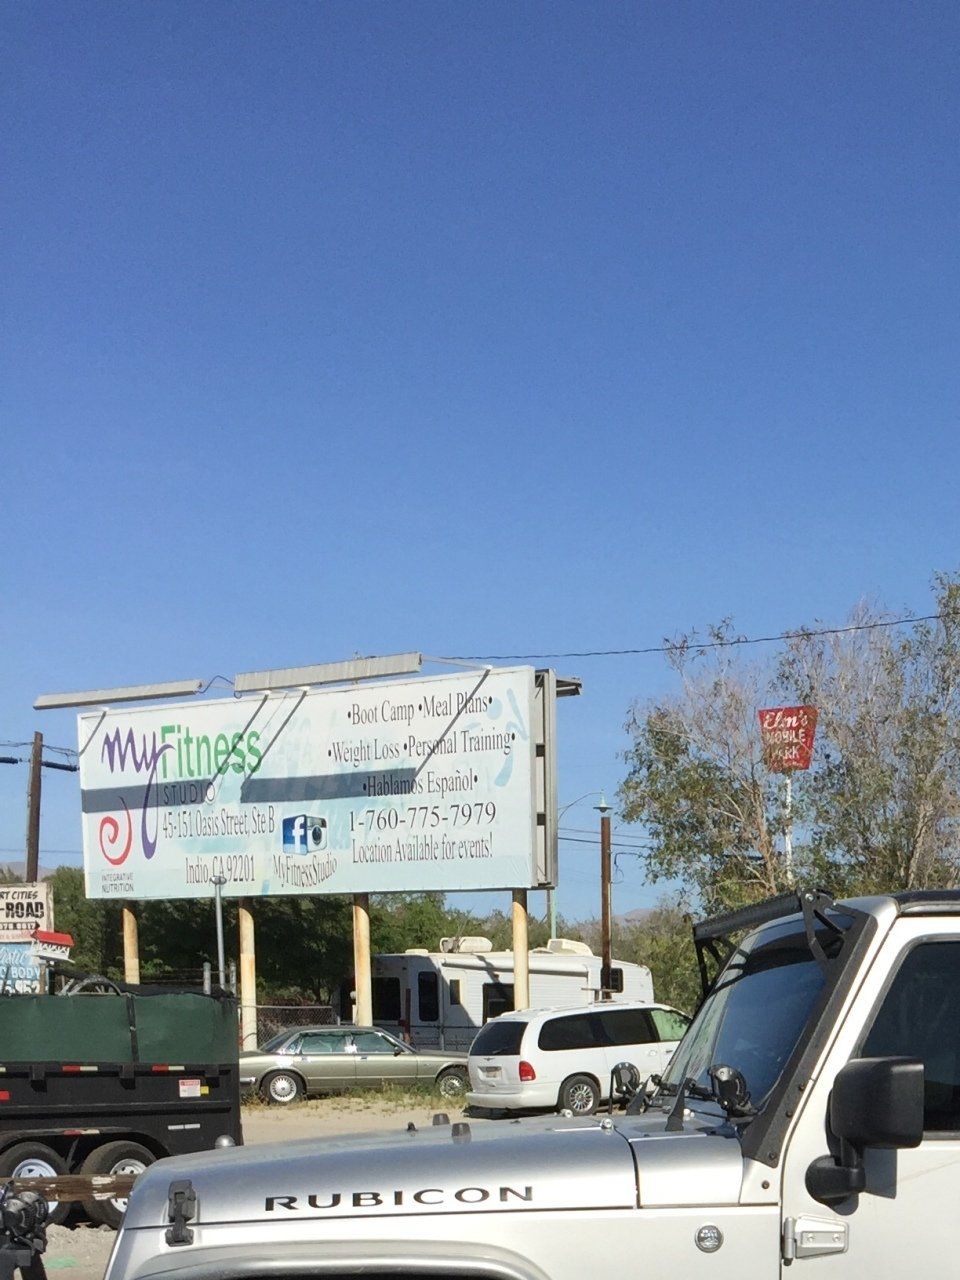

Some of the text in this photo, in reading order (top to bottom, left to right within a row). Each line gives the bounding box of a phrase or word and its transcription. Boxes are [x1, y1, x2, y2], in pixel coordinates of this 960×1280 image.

[352, 691, 488, 726] Boot Camp Meal Plans
[332, 727, 511, 767] Weight Loss Personal Training
[163, 782, 216, 805] STUDIO
[367, 768, 474, 798] Hablamos Español
[162, 810, 194, 839] 45-151
[196, 809, 219, 836] Oasis
[252, 807, 267, 834] Ste
[269, 805, 275, 834] B
[350, 801, 497, 832] 1-760-775-7979
[352, 832, 493, 864] Location Available for events!
[101, 872, 134, 882] INTEGRATIVE
[212, 855, 225, 879] CA
[227, 854, 256, 882] 92201
[273, 852, 338, 888] MyFitnessStudio
[11, 891, 38, 900] CITIES
[101, 882, 135, 893] NUTRITION
[265, 1186, 533, 1212] RUBICON
